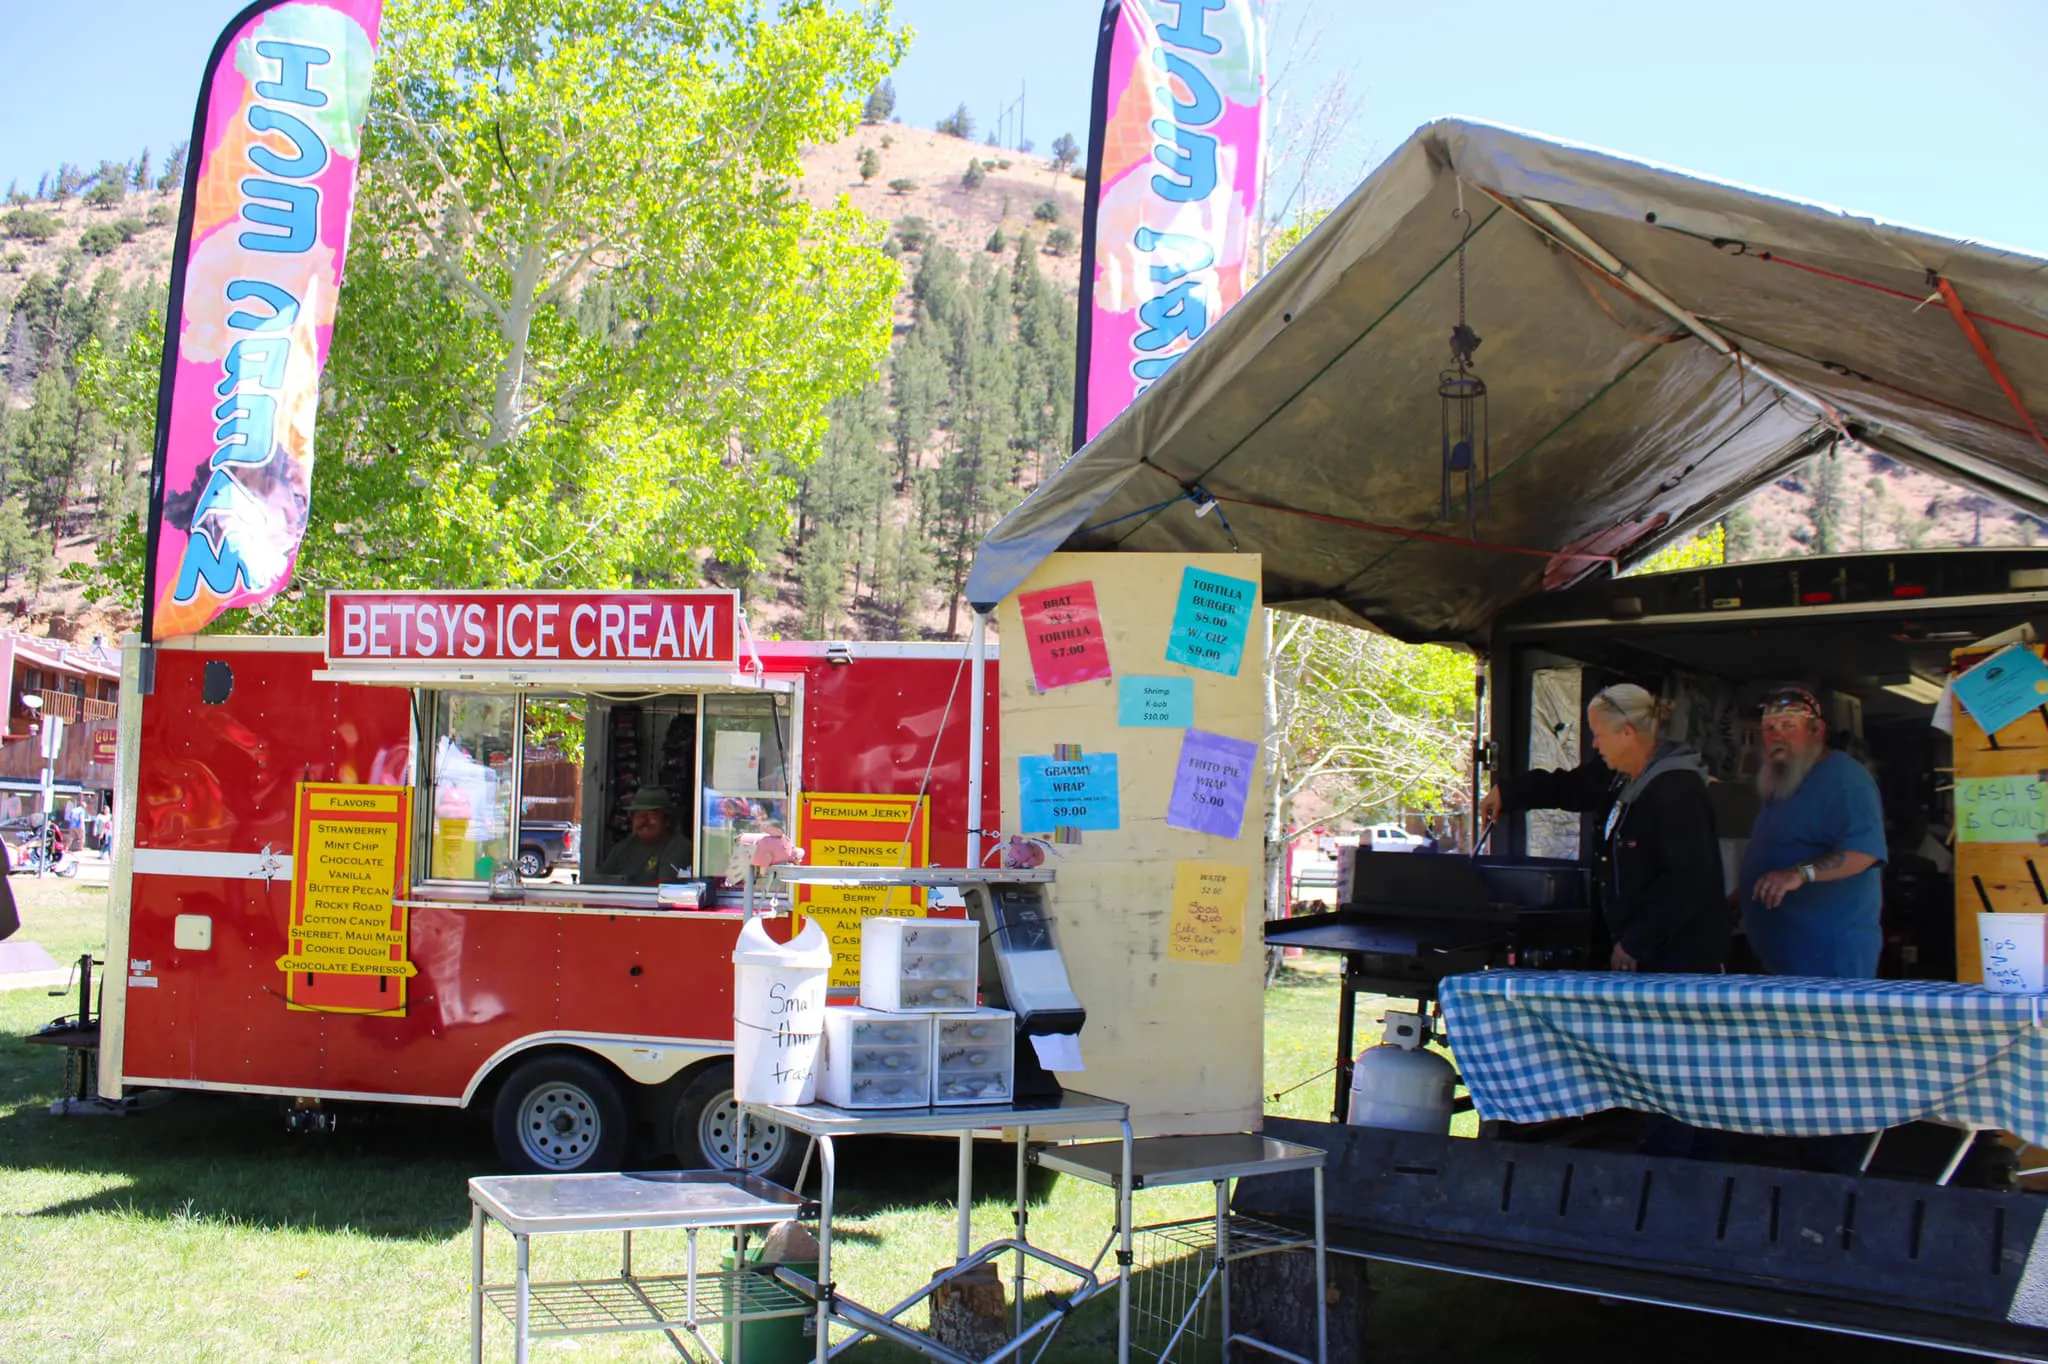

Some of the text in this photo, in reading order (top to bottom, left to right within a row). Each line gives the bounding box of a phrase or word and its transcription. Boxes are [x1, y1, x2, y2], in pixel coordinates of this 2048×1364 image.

[1193, 580, 1243, 600] TORTILLA
[1043, 596, 1073, 610] BRAT
[1192, 596, 1237, 615] BURGER
[1195, 612, 1228, 628] $8.00
[342, 603, 715, 659] BETSYS ICE CREAM
[1040, 627, 1091, 645] TORTILLA
[1050, 644, 1086, 659] $7.00
[1188, 644, 1221, 661] $9.00
[1143, 687, 1170, 697] Shrimp
[1143, 713, 1170, 722] $10.00
[95, 730, 116, 744] GOL
[1044, 765, 1092, 777] GRAMMY
[1188, 756, 1241, 779] FRITO PIE
[1053, 782, 1086, 793] WRAP
[1196, 776, 1228, 791] WRAP
[1191, 791, 1226, 808] $8.00
[1963, 782, 2016, 803] CASH
[329, 796, 377, 808] FLAVORS
[813, 806, 910, 818] PREMIUM JERKY
[1053, 806, 1088, 817] $9.00
[317, 824, 389, 836] STRAWBERRY
[324, 840, 380, 852] MINT CHIP
[838, 844, 884, 856] DRINKS
[319, 854, 385, 868] CHOCOLATE
[328, 870, 372, 881] VANILLA
[308, 882, 390, 896] BUTTER PECAN
[842, 893, 877, 903] BERRY
[314, 899, 384, 912] ROCKY ROAD
[806, 904, 858, 916] GERMAN
[304, 914, 386, 928] COTTON CANDY
[836, 920, 862, 930] ALM
[345, 930, 374, 942] MAUI
[376, 932, 404, 944] MAUI
[306, 943, 386, 958] COOKIE DOUGH
[836, 952, 861, 962] PEC
[283, 959, 408, 975] CHOCOLATE EXPRESSO
